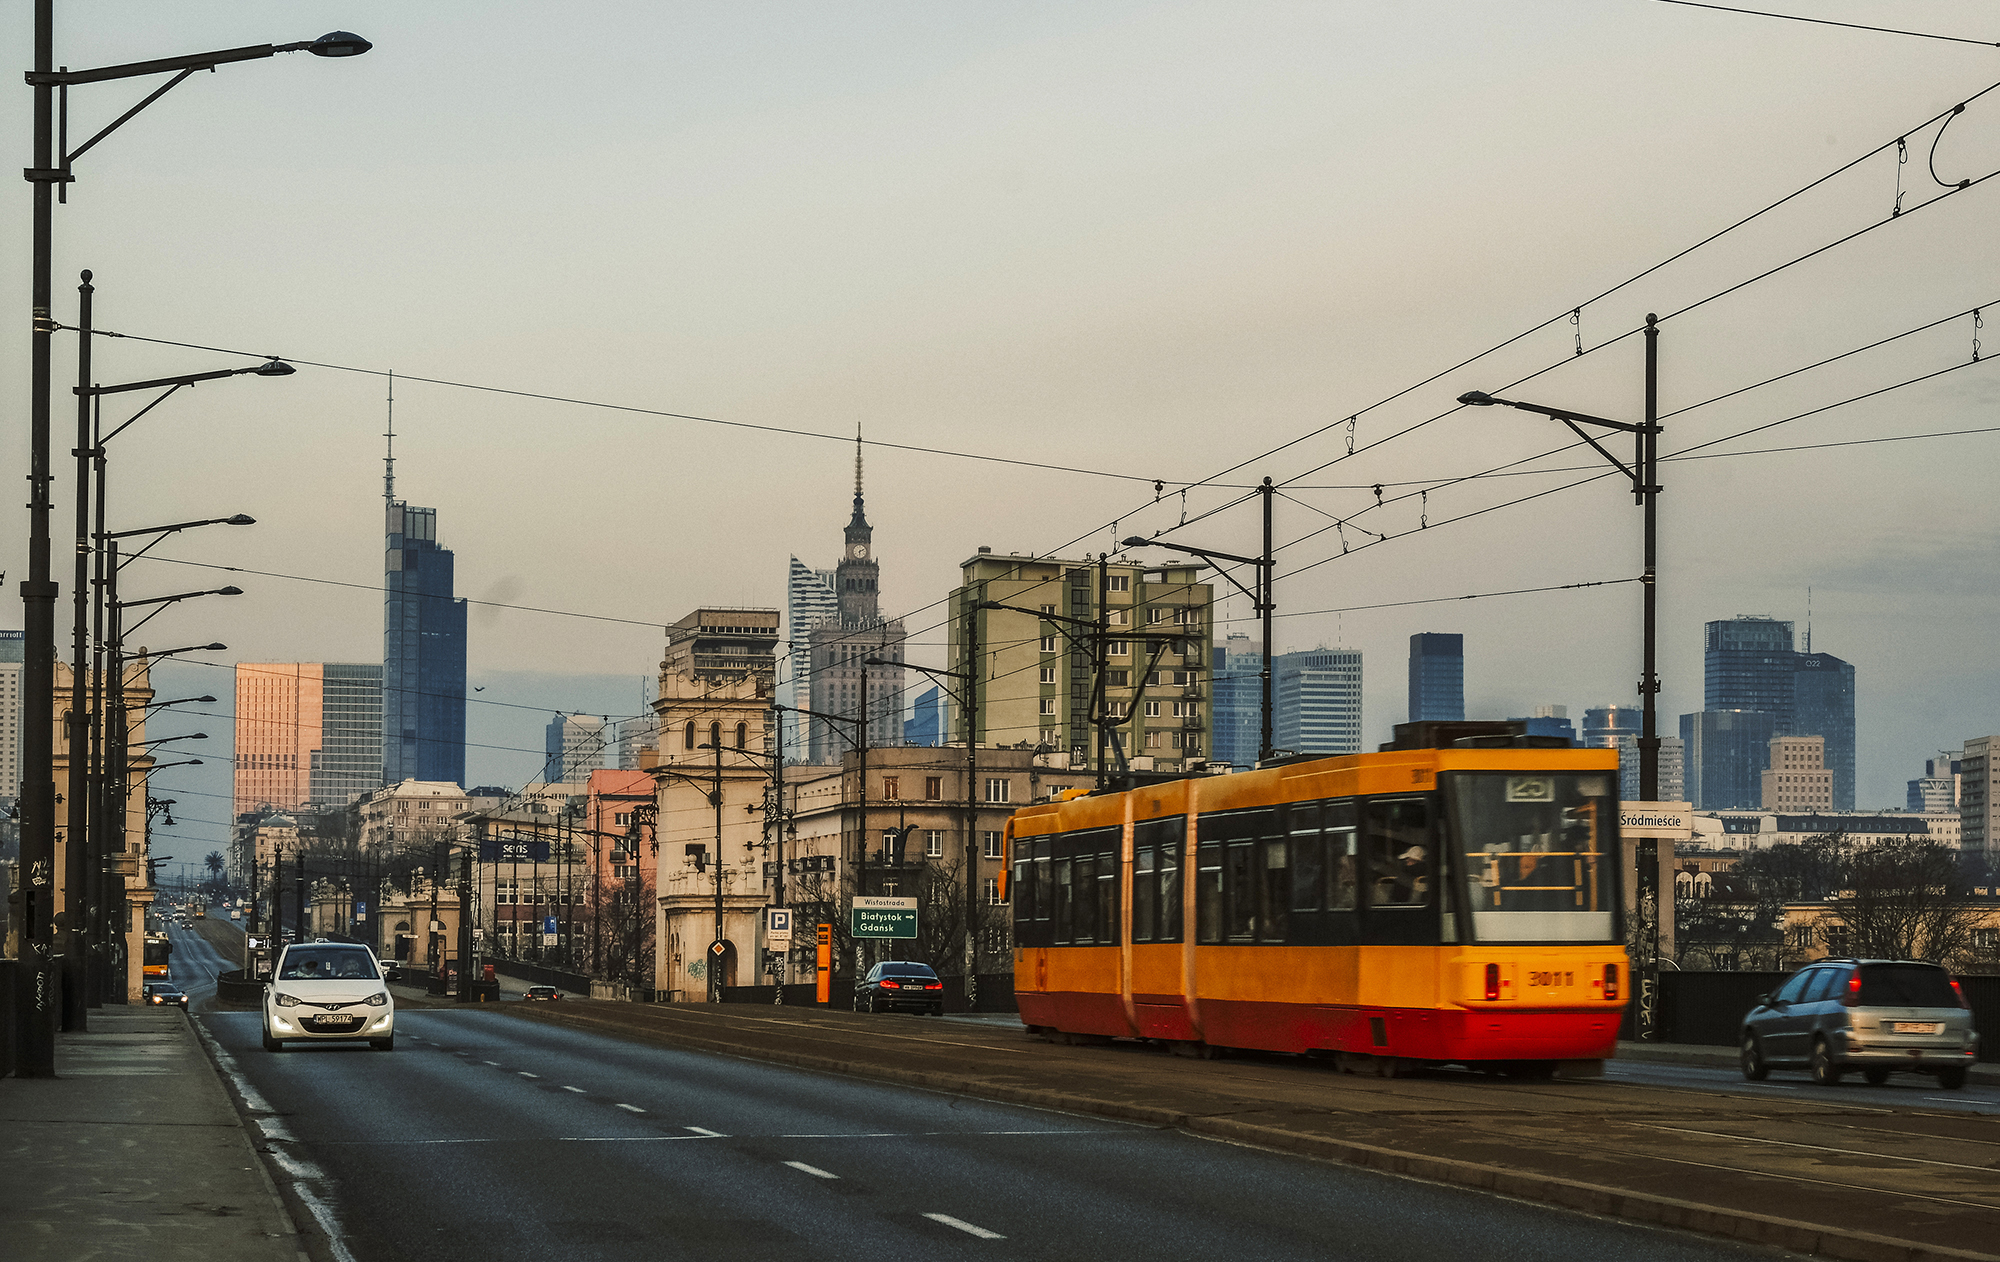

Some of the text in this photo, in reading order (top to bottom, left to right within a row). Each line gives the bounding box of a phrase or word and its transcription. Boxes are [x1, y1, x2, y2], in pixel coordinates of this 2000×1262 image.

[1620, 812, 1681, 827] Śródmieście
[775, 914, 785, 928] P
[861, 912, 902, 923] Białystok
[860, 923, 894, 932] Gdańsk
[1528, 971, 1574, 986] 3011
